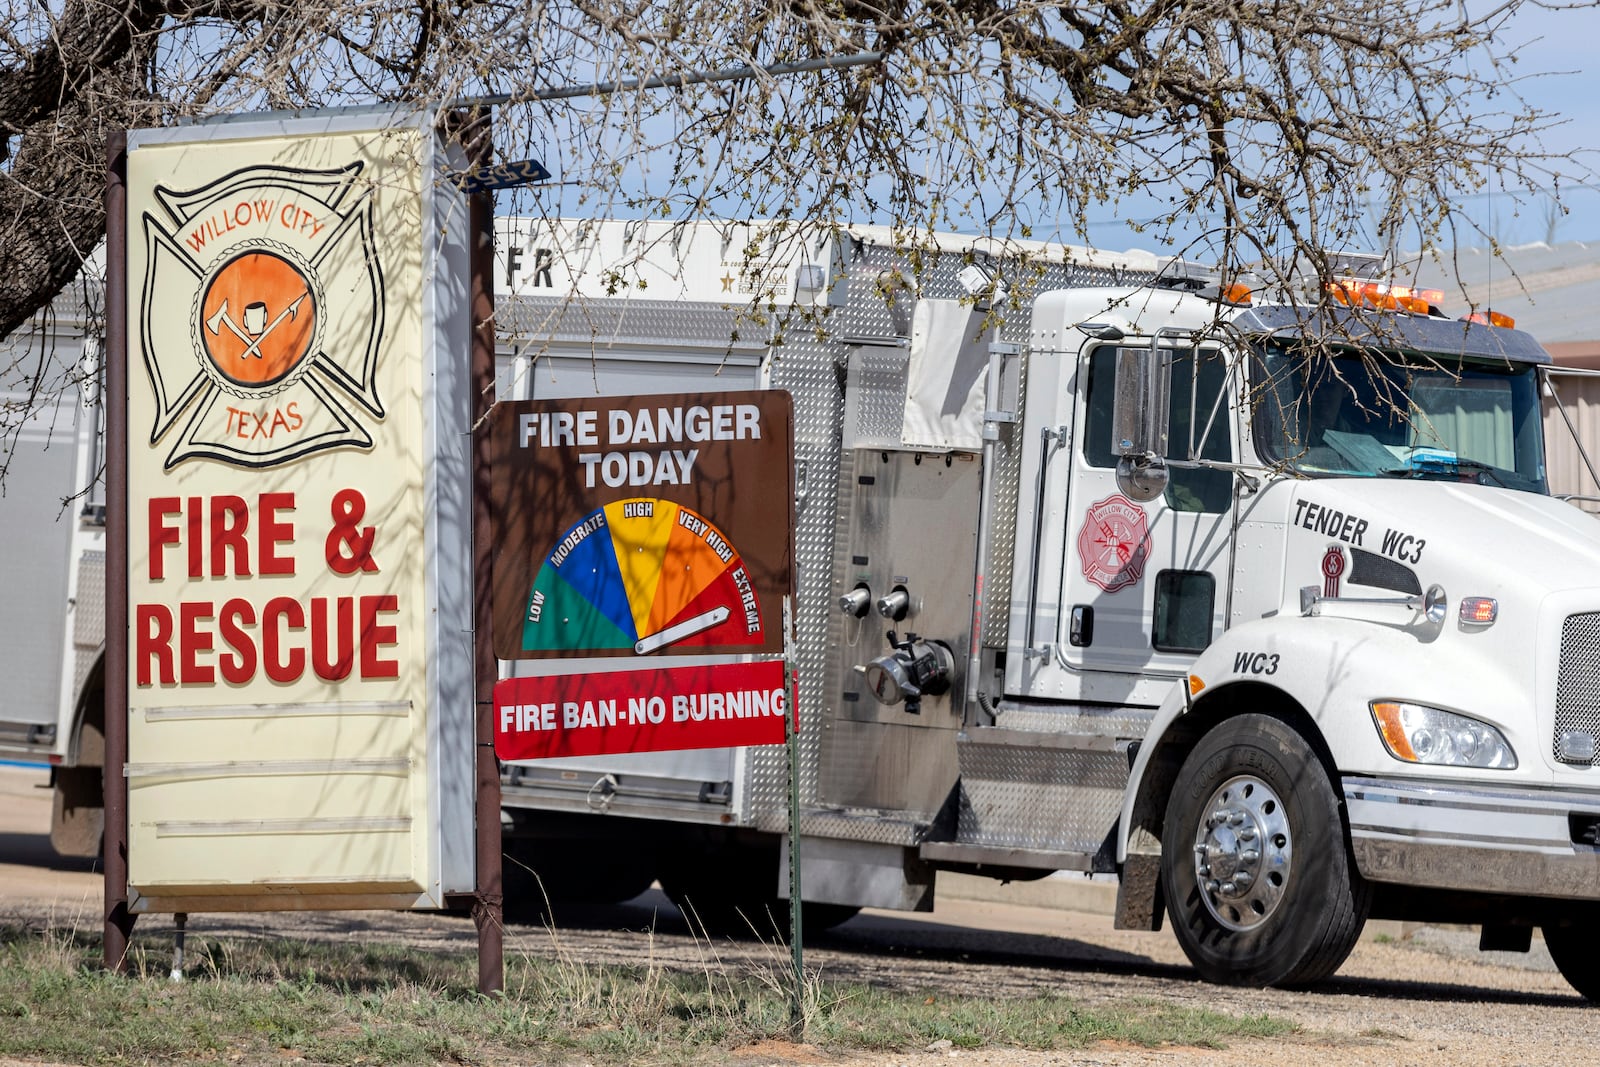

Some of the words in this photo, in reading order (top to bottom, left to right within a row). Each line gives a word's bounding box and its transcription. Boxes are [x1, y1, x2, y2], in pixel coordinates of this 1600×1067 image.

[186, 199, 275, 254] WILLOW
[280, 203, 326, 241] CITY
[225, 401, 303, 440] TEXAS
[519, 411, 598, 448] FIRE
[608, 404, 761, 445] DANGER
[579, 449, 699, 488] TODAY
[624, 502, 653, 518] HIGH
[1294, 498, 1369, 547] TENDER
[1380, 528, 1426, 565] WC3
[148, 493, 295, 580] FIRE
[325, 489, 379, 574] &
[550, 512, 605, 568] MODERATE
[678, 510, 708, 537] VERY
[705, 530, 734, 563] HIGH
[528, 590, 545, 623] LOW
[732, 567, 760, 634] EXTREME
[136, 595, 399, 685] RESCUE
[1233, 652, 1280, 675] WC3
[500, 703, 557, 733] FIRE
[563, 696, 667, 729] BAN-NO
[672, 689, 785, 723] BURNING
